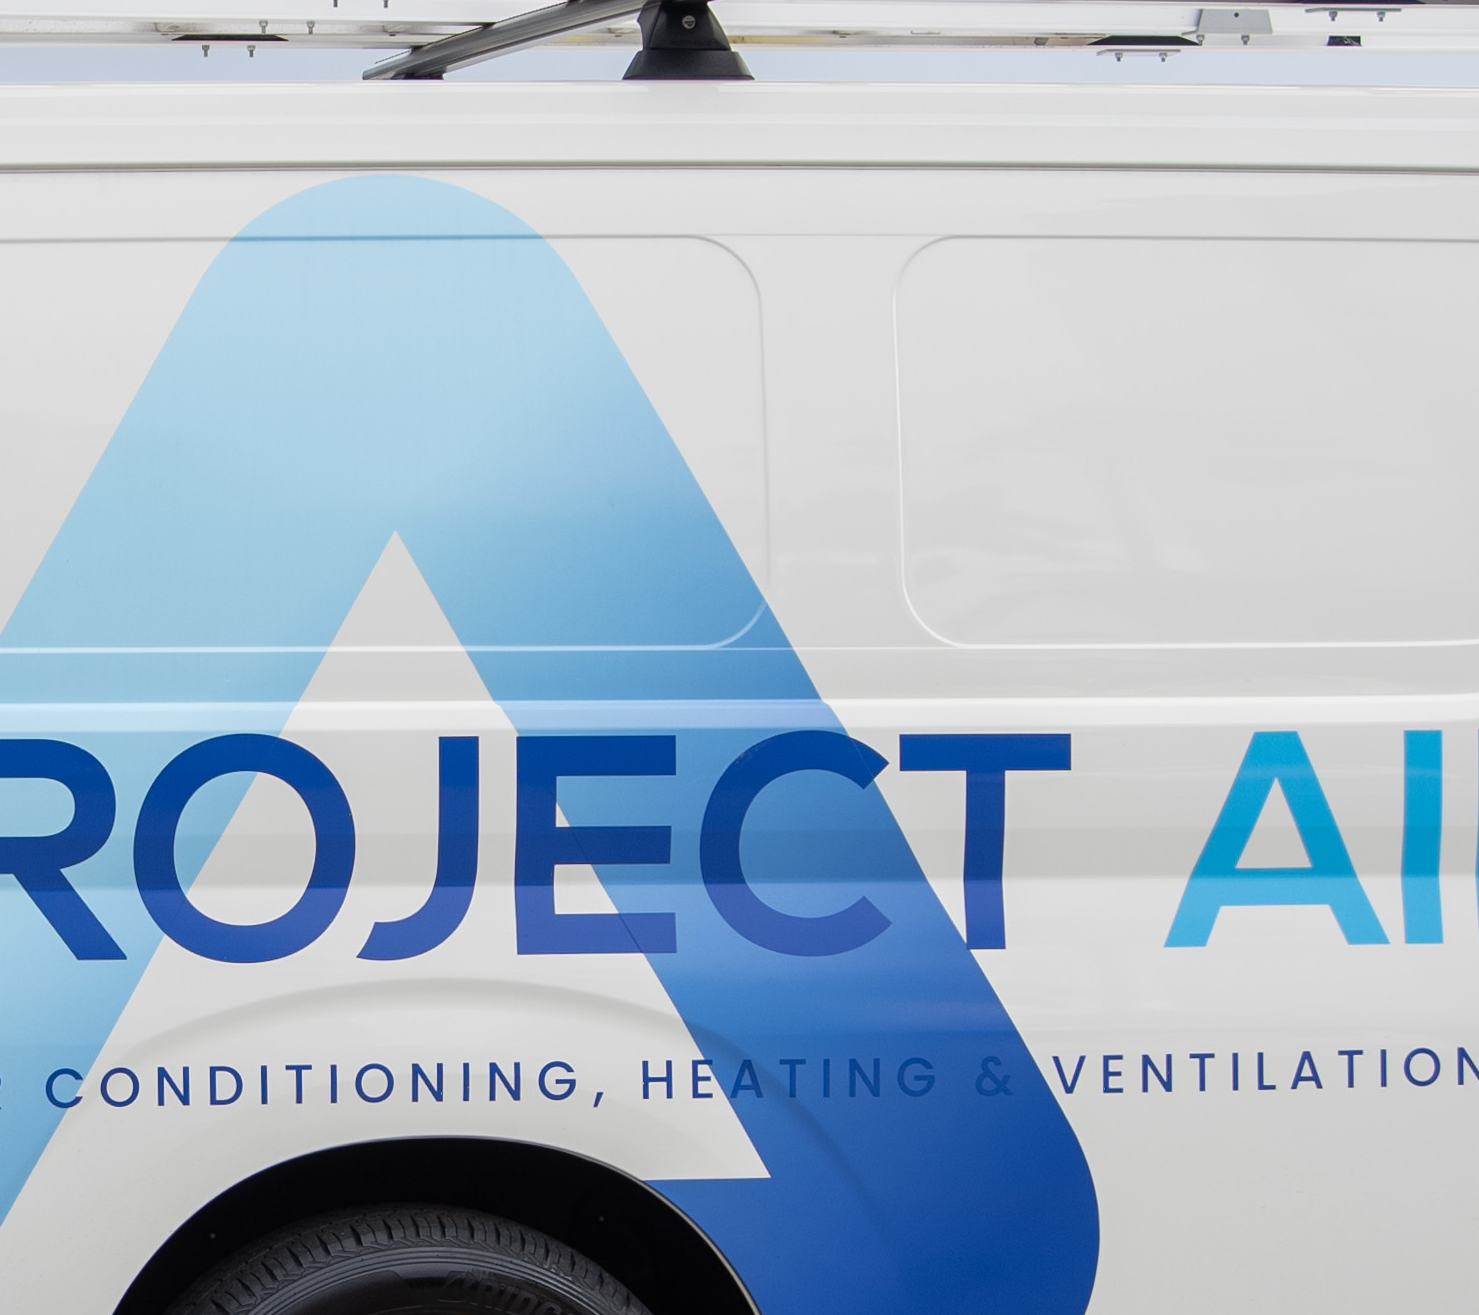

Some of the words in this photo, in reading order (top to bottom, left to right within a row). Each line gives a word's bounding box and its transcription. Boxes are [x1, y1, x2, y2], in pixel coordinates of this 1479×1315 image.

[45, 1060, 605, 1109] CONDITIONING,
[642, 1057, 938, 1099] HEATING
[973, 1055, 1013, 1096] &
